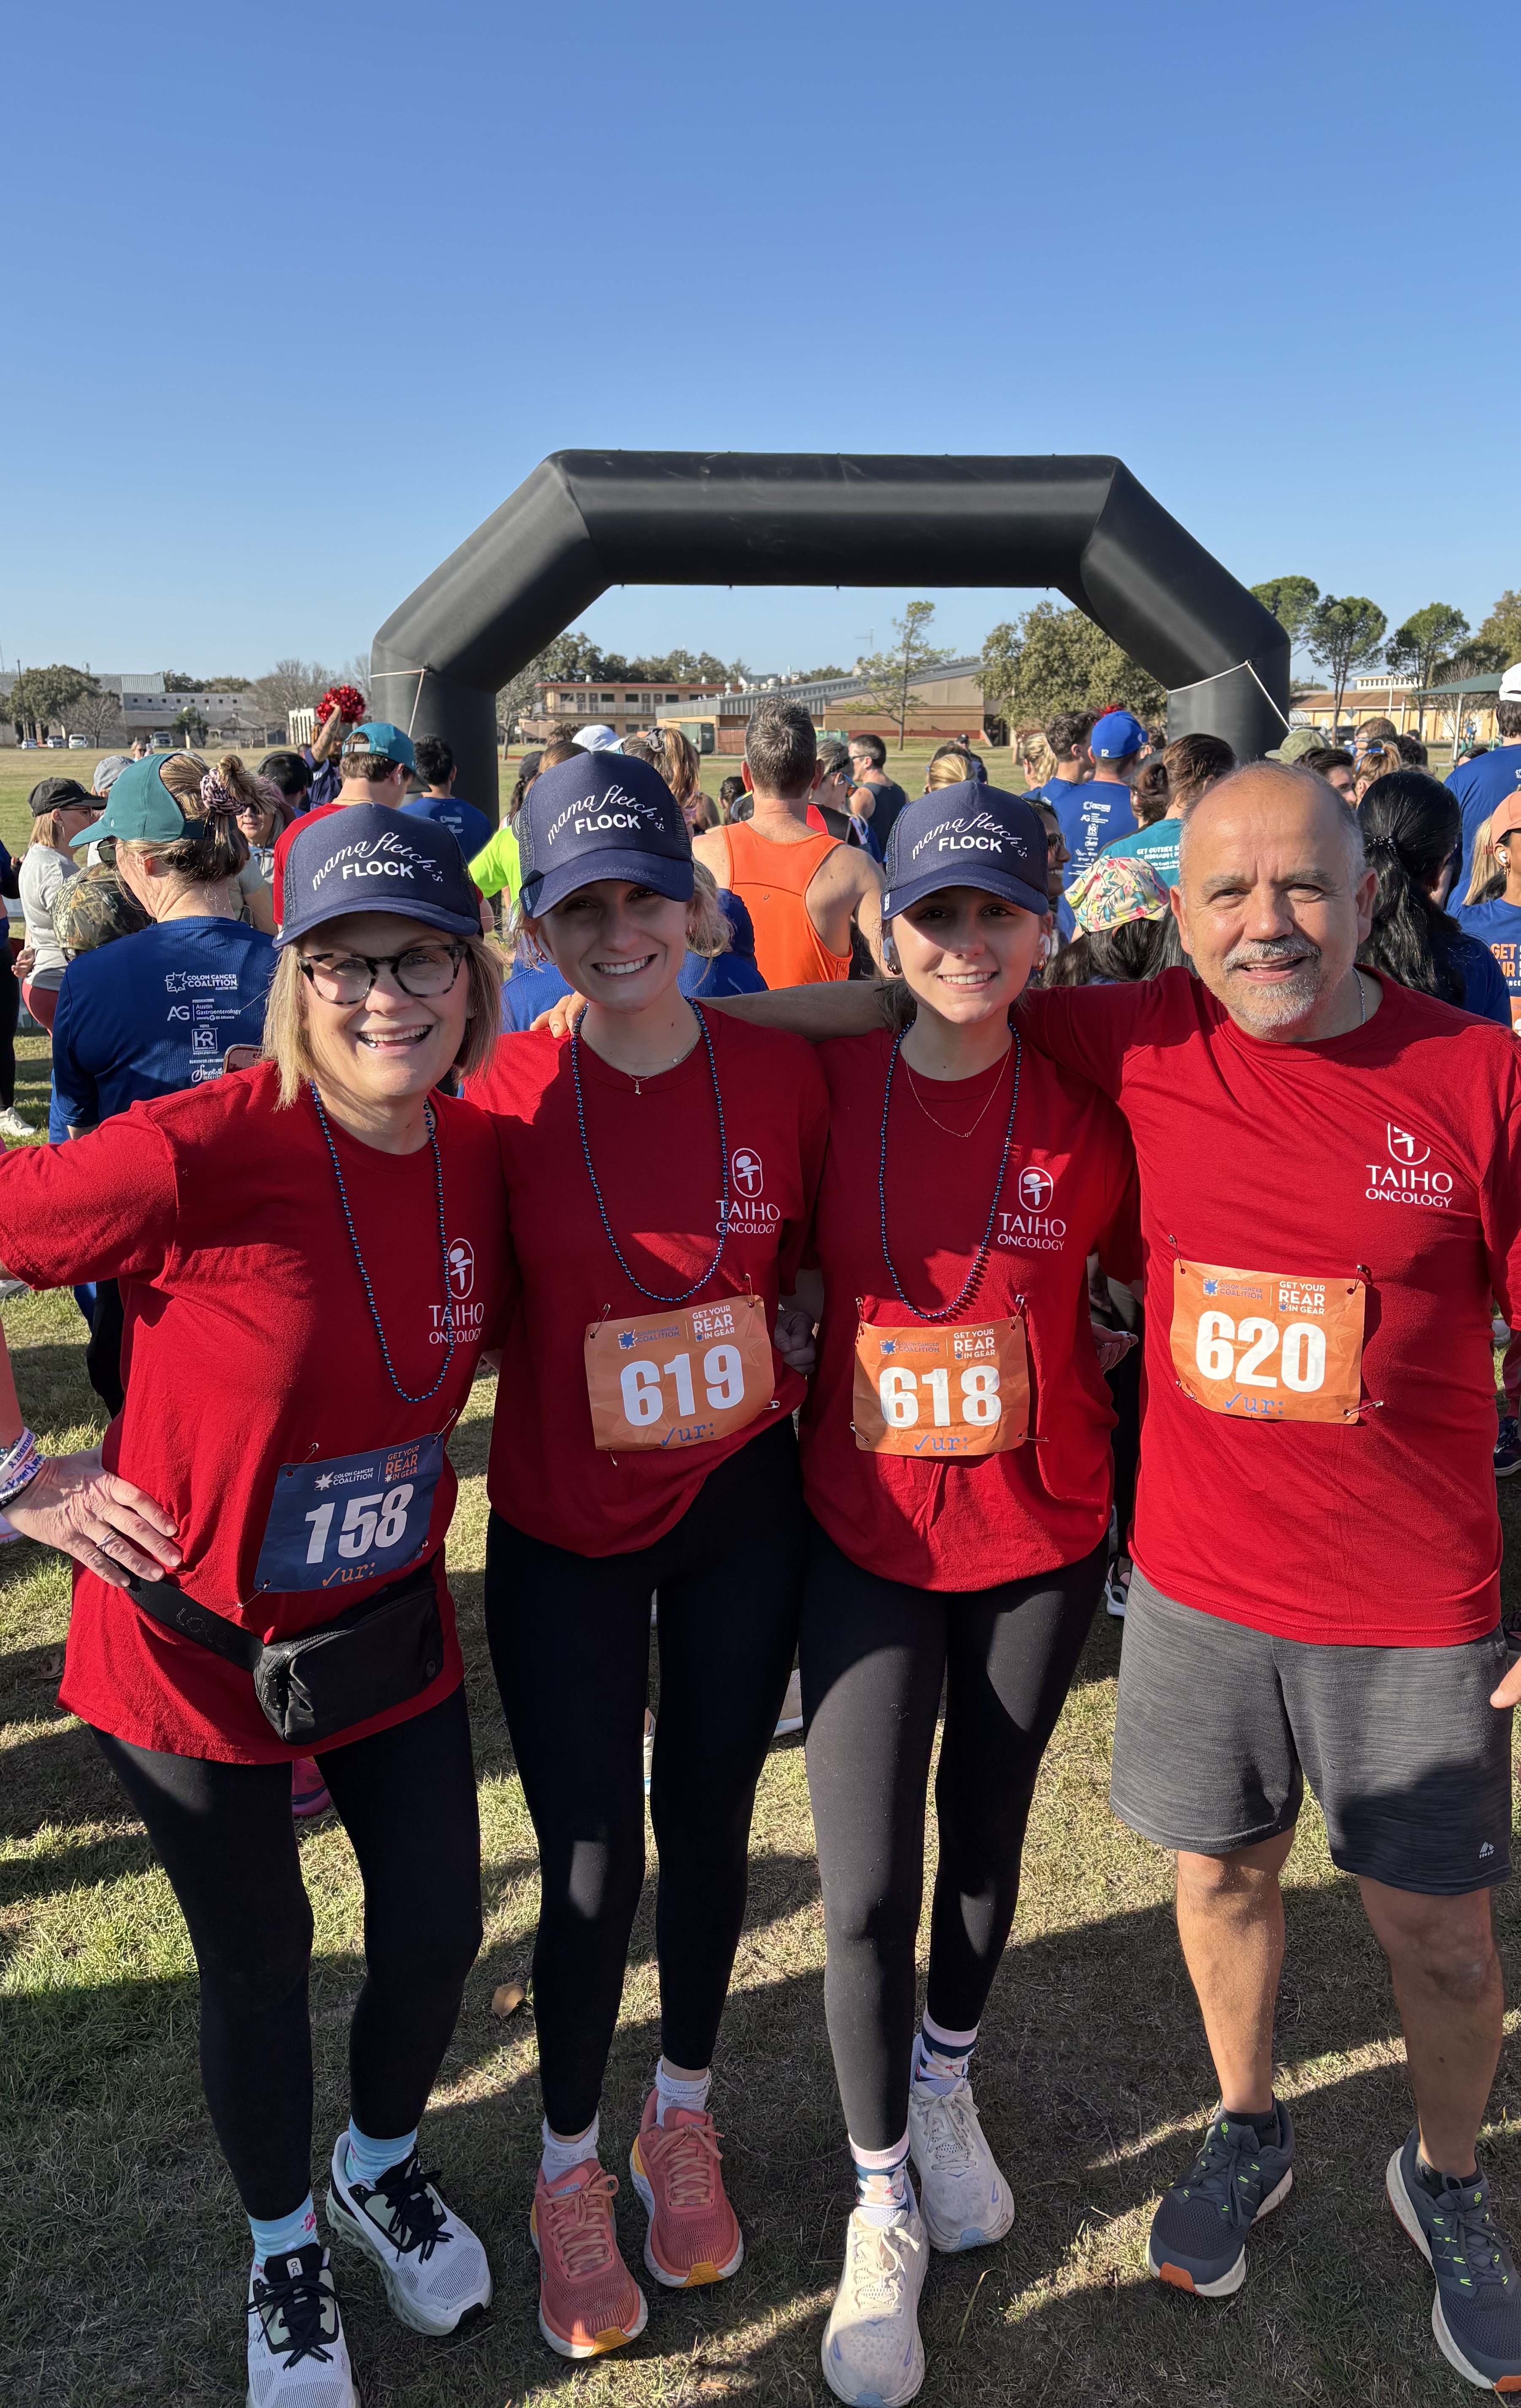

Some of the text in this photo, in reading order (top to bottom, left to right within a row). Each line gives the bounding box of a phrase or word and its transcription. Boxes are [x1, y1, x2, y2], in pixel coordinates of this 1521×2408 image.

[1101, 749, 1109, 757] 12
[548, 785, 665, 845] mama fletch's
[575, 814, 641, 834] FLOCK
[912, 812, 1027, 860] mama fletch's
[939, 836, 1002, 853] FLOCK
[313, 832, 443, 891] mama fletch's
[342, 861, 414, 880] FLOCK
[1491, 943, 1517, 959] GET
[188, 979, 237, 987] COALITION
[167, 1006, 190, 1021] AG
[1366, 1165, 1453, 1193] TAIHO
[1365, 1188, 1452, 1208] ONCOLOGY
[716, 1201, 780, 1221] TAIHO
[716, 1222, 776, 1234] ONCOLOGY
[999, 1212, 1066, 1237] TAIHO
[997, 1234, 1064, 1250] ONCOLOGY
[1220, 1288, 1263, 1299] COALITION
[1279, 1281, 1326, 1292] GET YOUR
[1279, 1289, 1325, 1307] REAR
[429, 1302, 484, 1327] TAIHO
[692, 1305, 731, 1319] GET YOUR
[1300, 1306, 1325, 1315] GEAR
[694, 1314, 733, 1333] REAR
[638, 1330, 681, 1343] COALITION
[714, 1327, 735, 1337] GEAR
[971, 1328, 994, 1337] YOUR
[954, 1337, 995, 1352] REAR
[1196, 1310, 1326, 1393] 620
[974, 1349, 995, 1358] GEAR
[621, 1344, 744, 1426] 619
[879, 1365, 1001, 1428] 618
[388, 1445, 419, 1460] GET YOUR
[354, 1467, 374, 1475] CANCER
[385, 1454, 418, 1474] REAR
[333, 1473, 373, 1485] COALITION
[401, 1467, 417, 1478] GEAR
[305, 1484, 414, 1564] 158
